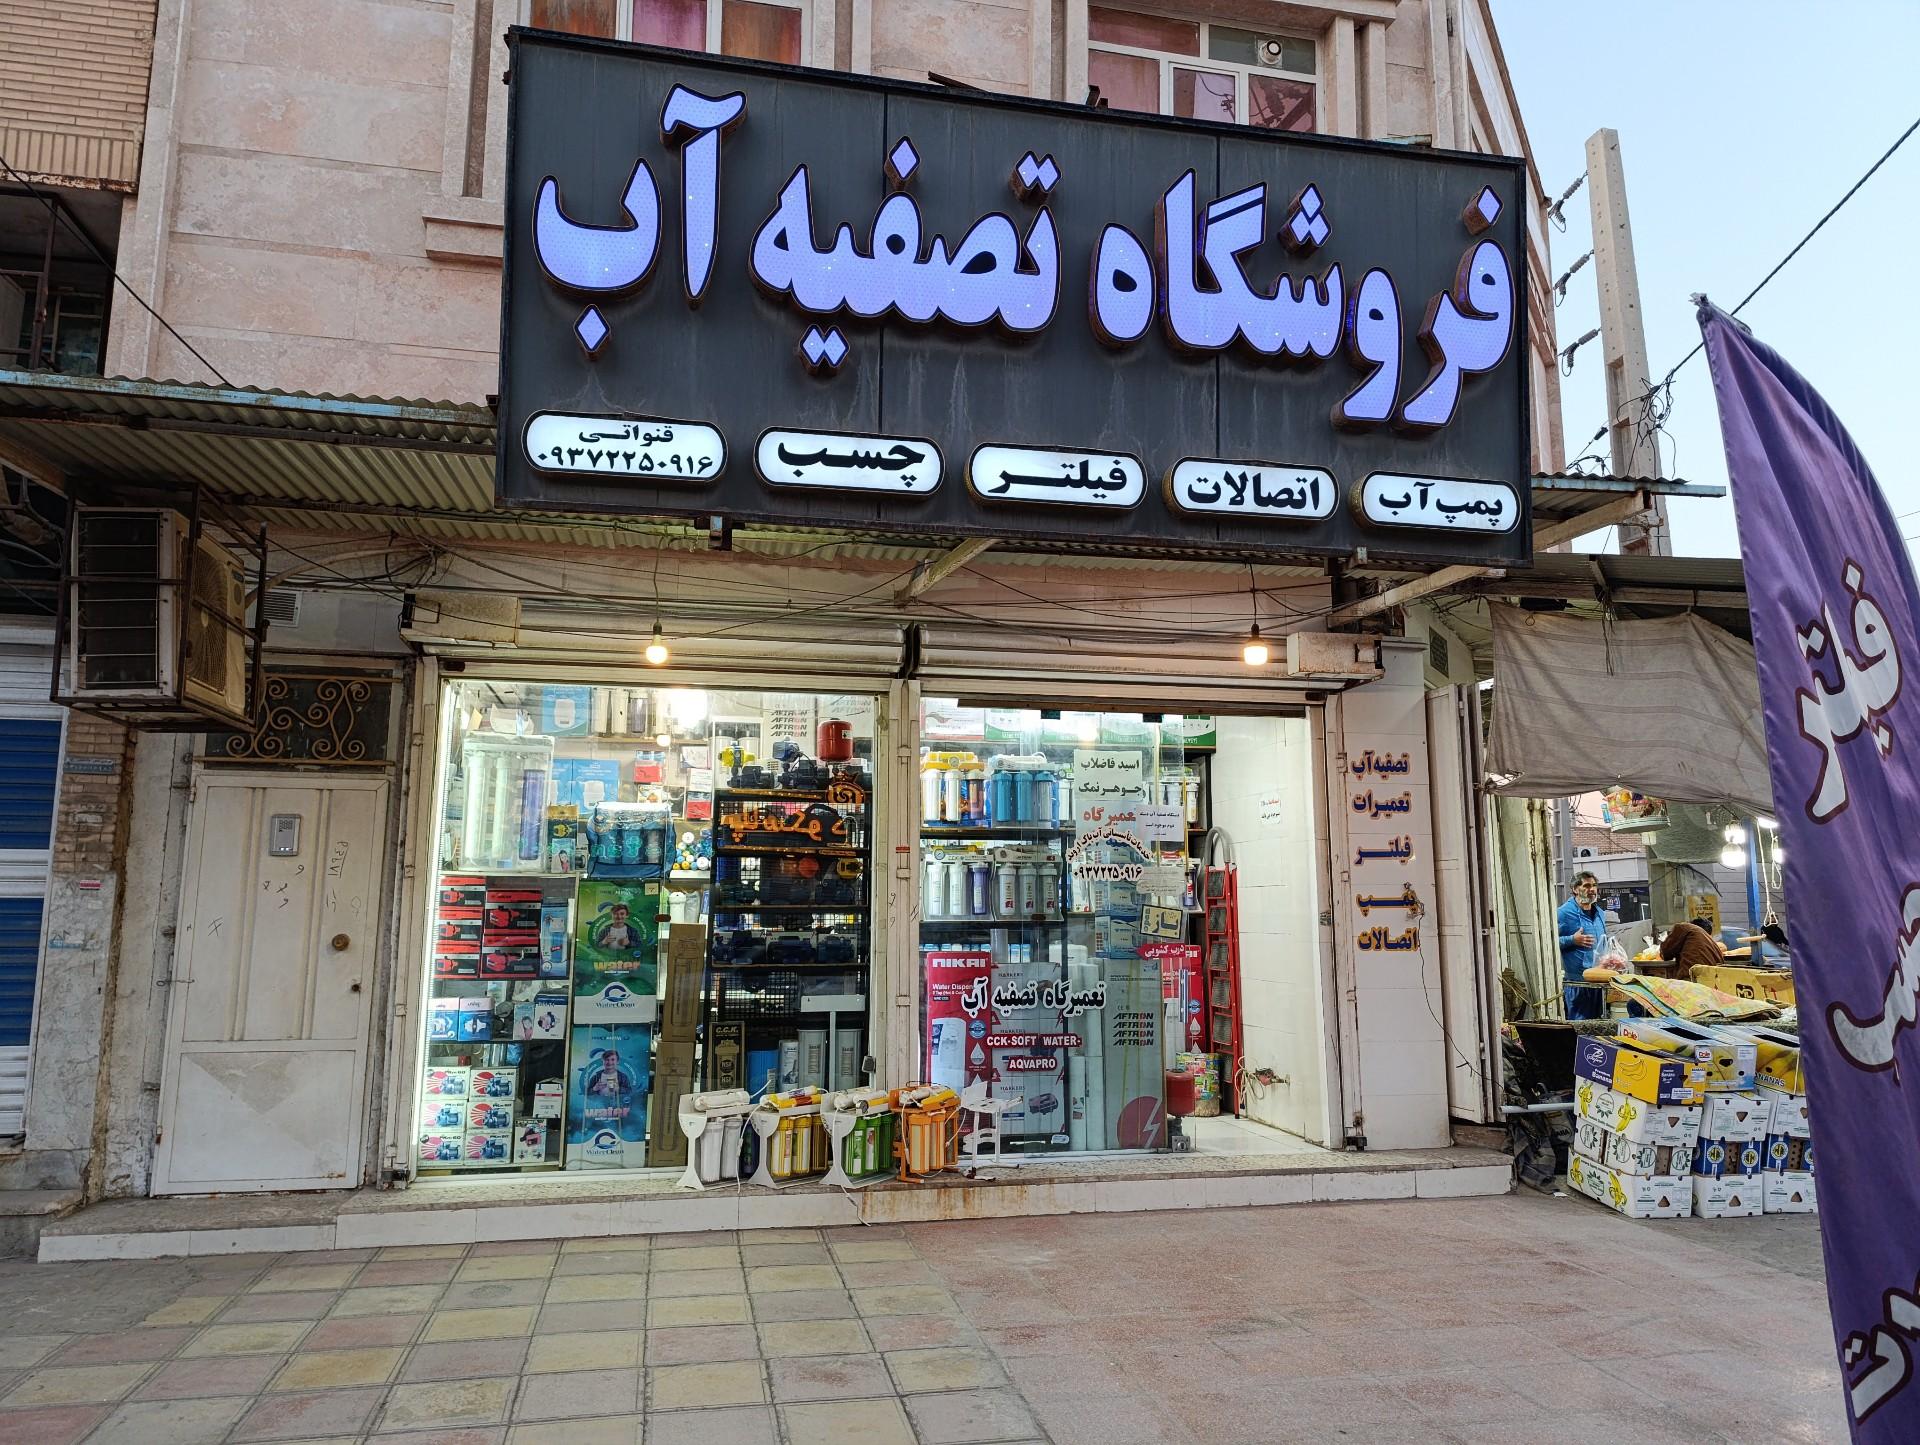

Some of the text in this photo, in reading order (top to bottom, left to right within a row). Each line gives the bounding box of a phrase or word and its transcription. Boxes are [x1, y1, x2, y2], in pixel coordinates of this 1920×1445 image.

[534, 83, 1516, 430] فروشگاه تصفیه آب
[578, 424, 675, 447] قنواتی
[537, 446, 714, 475] ۰۹۳۷۲۲۵۰۹۱۶
[777, 442, 926, 488] چسب
[987, 459, 1128, 499] فیلتر
[1187, 470, 1321, 511] اتصالات
[1378, 481, 1503, 527] پمپ آب
[1797, 560, 1902, 822] فیلتر
[1080, 757, 1140, 772] اسید فاضلاب
[1351, 750, 1410, 780] تصفیه آب
[1352, 790, 1411, 819] تعمیرات
[1104, 811, 1137, 827] عمیر
[1354, 834, 1413, 866] فیلتر
[1357, 926, 1419, 952] اتصالات
[932, 958, 987, 968] NIKAI
[951, 983, 975, 991] Dispen
[961, 976, 1107, 1018] تعمیرگاه تصفیه آب
[1113, 1012, 1154, 1020] AFTRON
[1113, 1021, 1154, 1029] AFTRON
[1113, 1030, 1154, 1038] AFTRON
[1113, 1038, 1154, 1046] AFTRON
[1009, 1058, 1057, 1070] AQVAPRO
